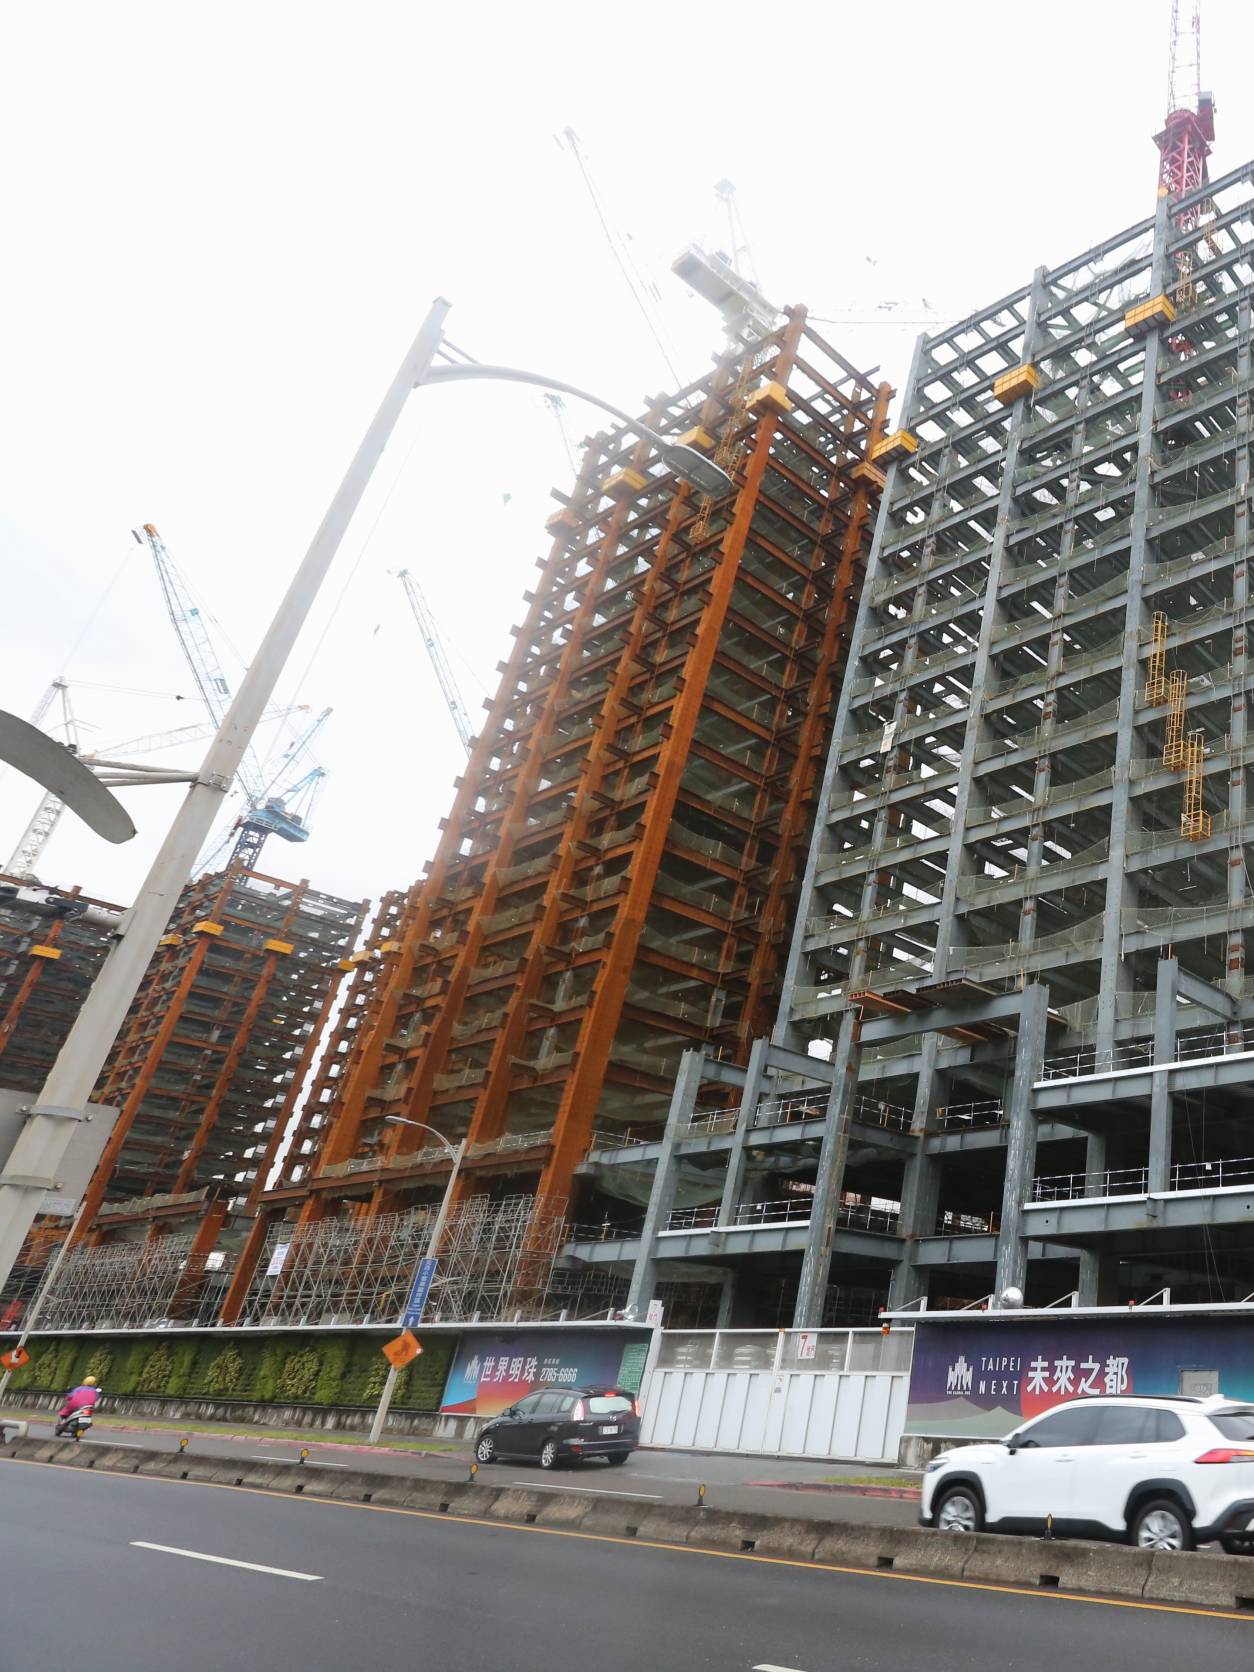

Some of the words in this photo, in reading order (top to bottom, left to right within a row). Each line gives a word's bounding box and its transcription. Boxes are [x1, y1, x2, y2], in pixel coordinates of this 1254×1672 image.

[481, 1356, 538, 1383] 世界明珠
[981, 1357, 1021, 1371] TAIPEI
[540, 1367, 578, 1382] 2785-6666
[1026, 1355, 1129, 1395] 未來之都
[979, 1380, 1019, 1395] NEXT
